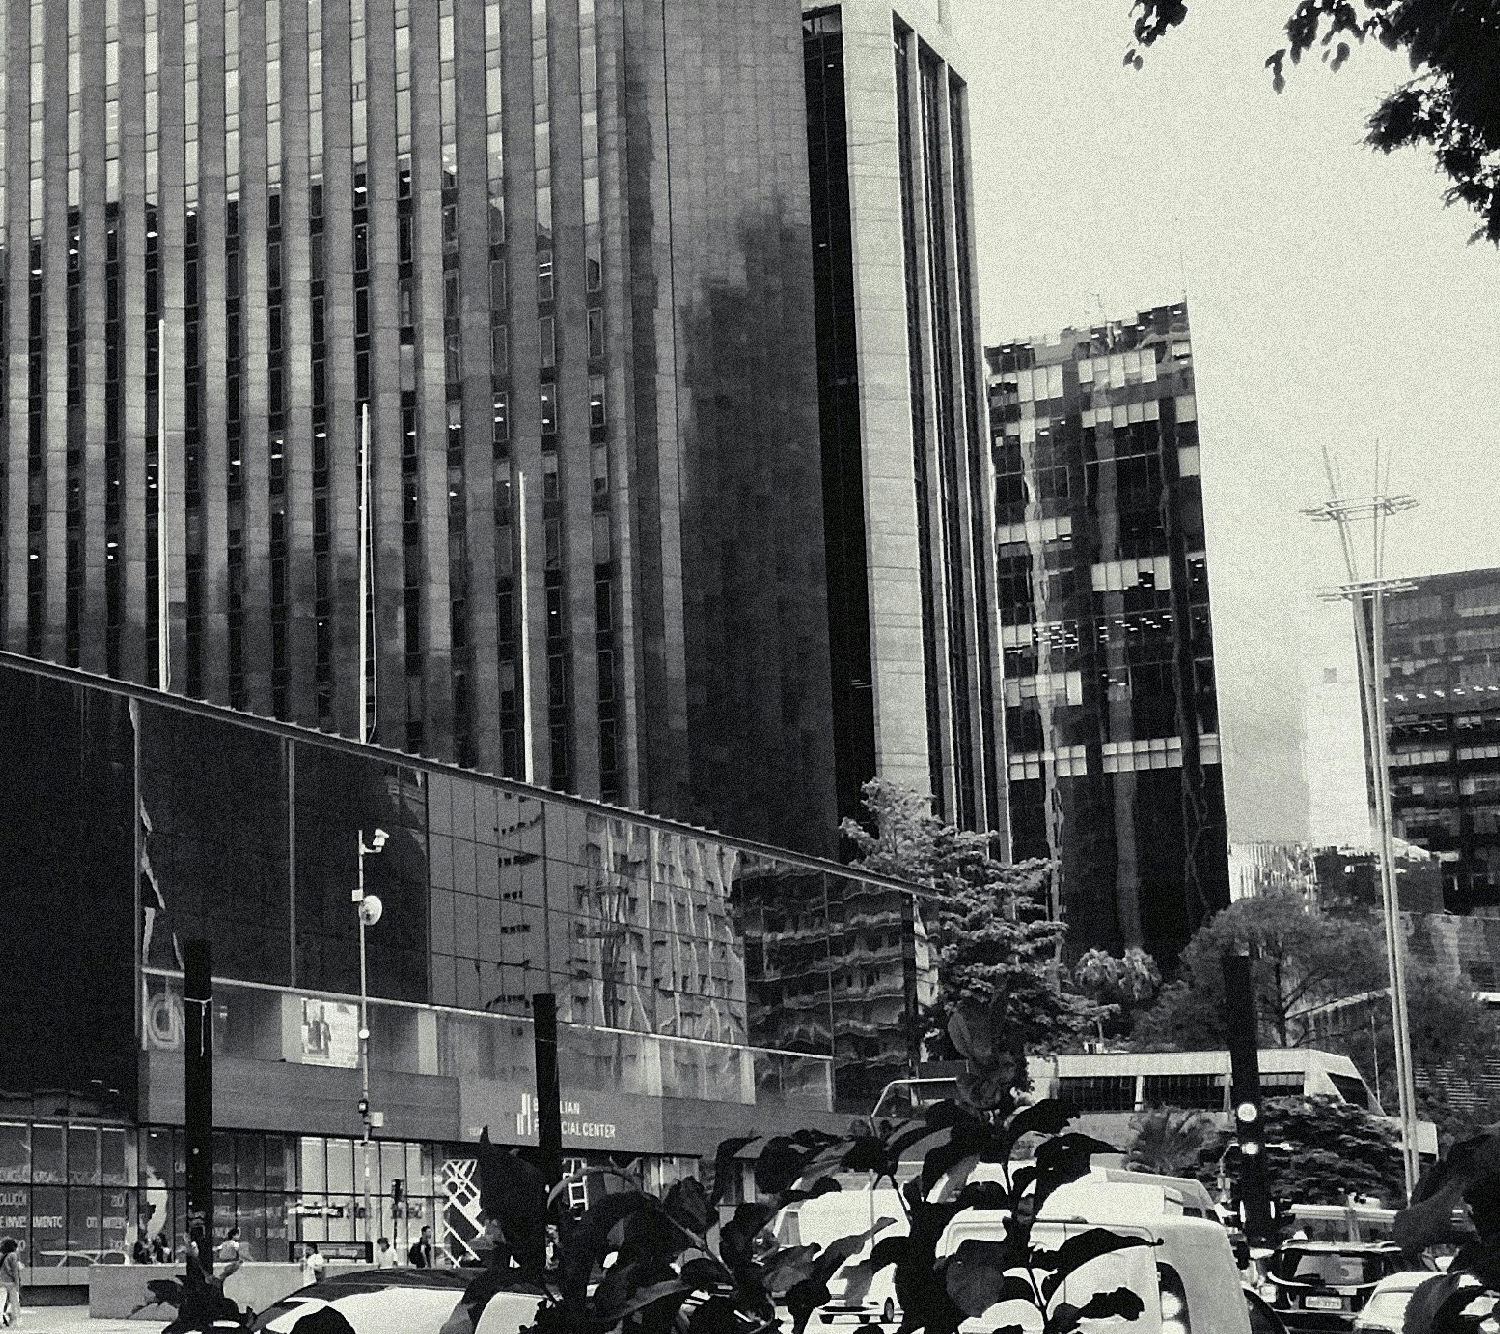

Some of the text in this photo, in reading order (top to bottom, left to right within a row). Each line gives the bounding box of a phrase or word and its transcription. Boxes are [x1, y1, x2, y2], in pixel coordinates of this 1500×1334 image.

[532, 1096, 581, 1115] BLIAN
[534, 1118, 616, 1138] FCIAL CENTER
